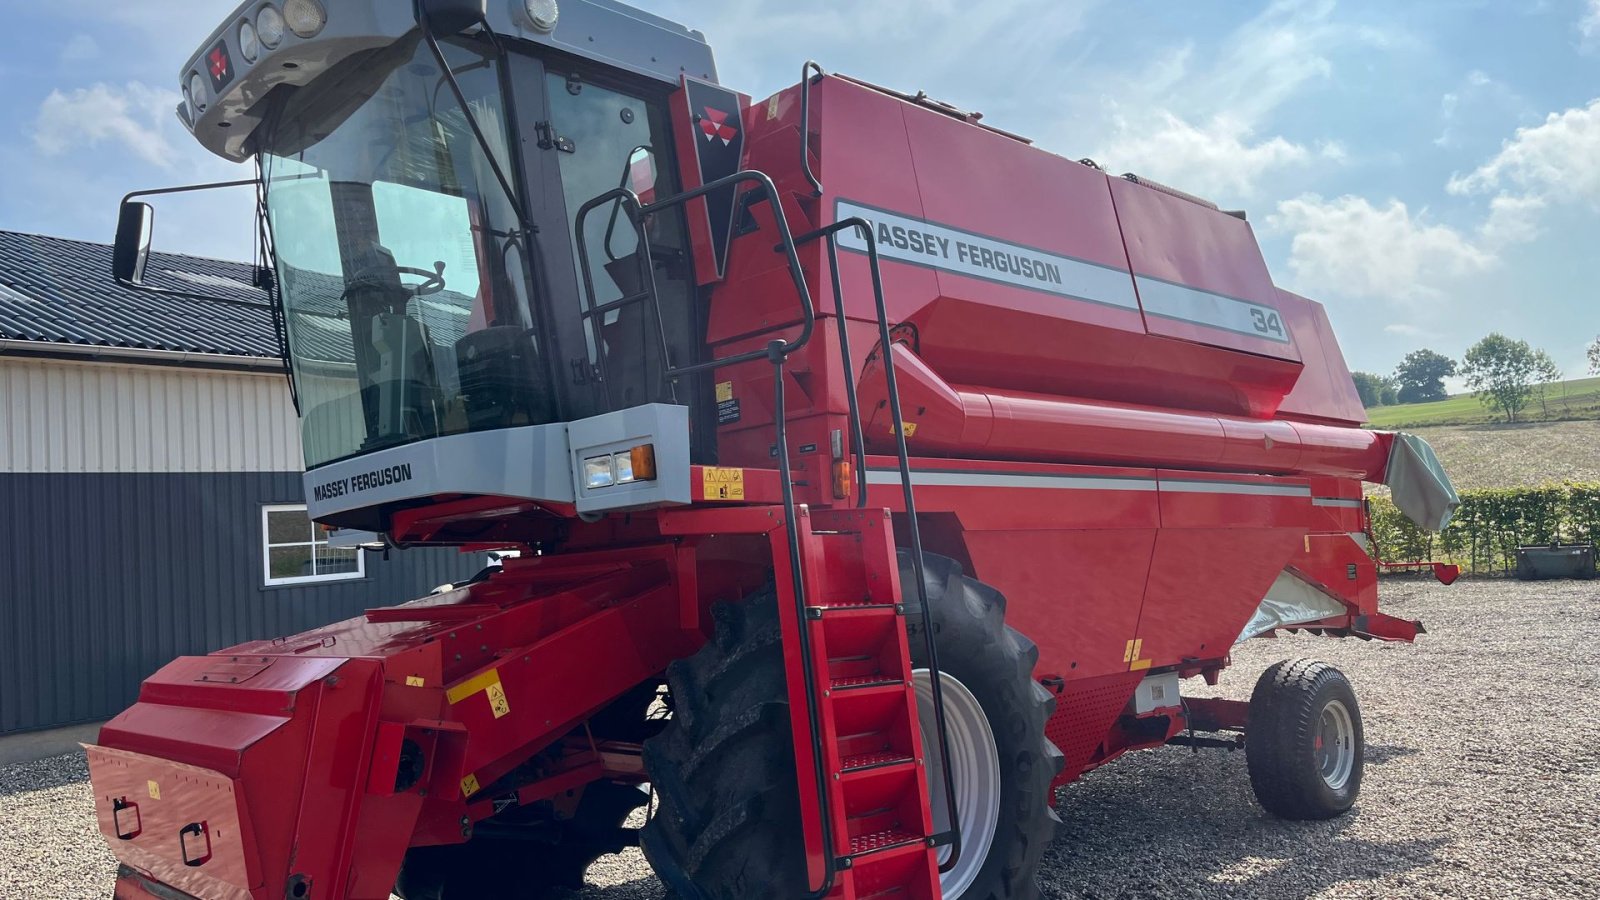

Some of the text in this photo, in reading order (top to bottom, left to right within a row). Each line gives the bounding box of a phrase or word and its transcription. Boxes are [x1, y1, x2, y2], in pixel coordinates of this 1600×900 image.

[956, 241, 1062, 284] FERGUSON
[1250, 308, 1282, 337] 34
[313, 463, 412, 502] MASSEY FERGUSON
